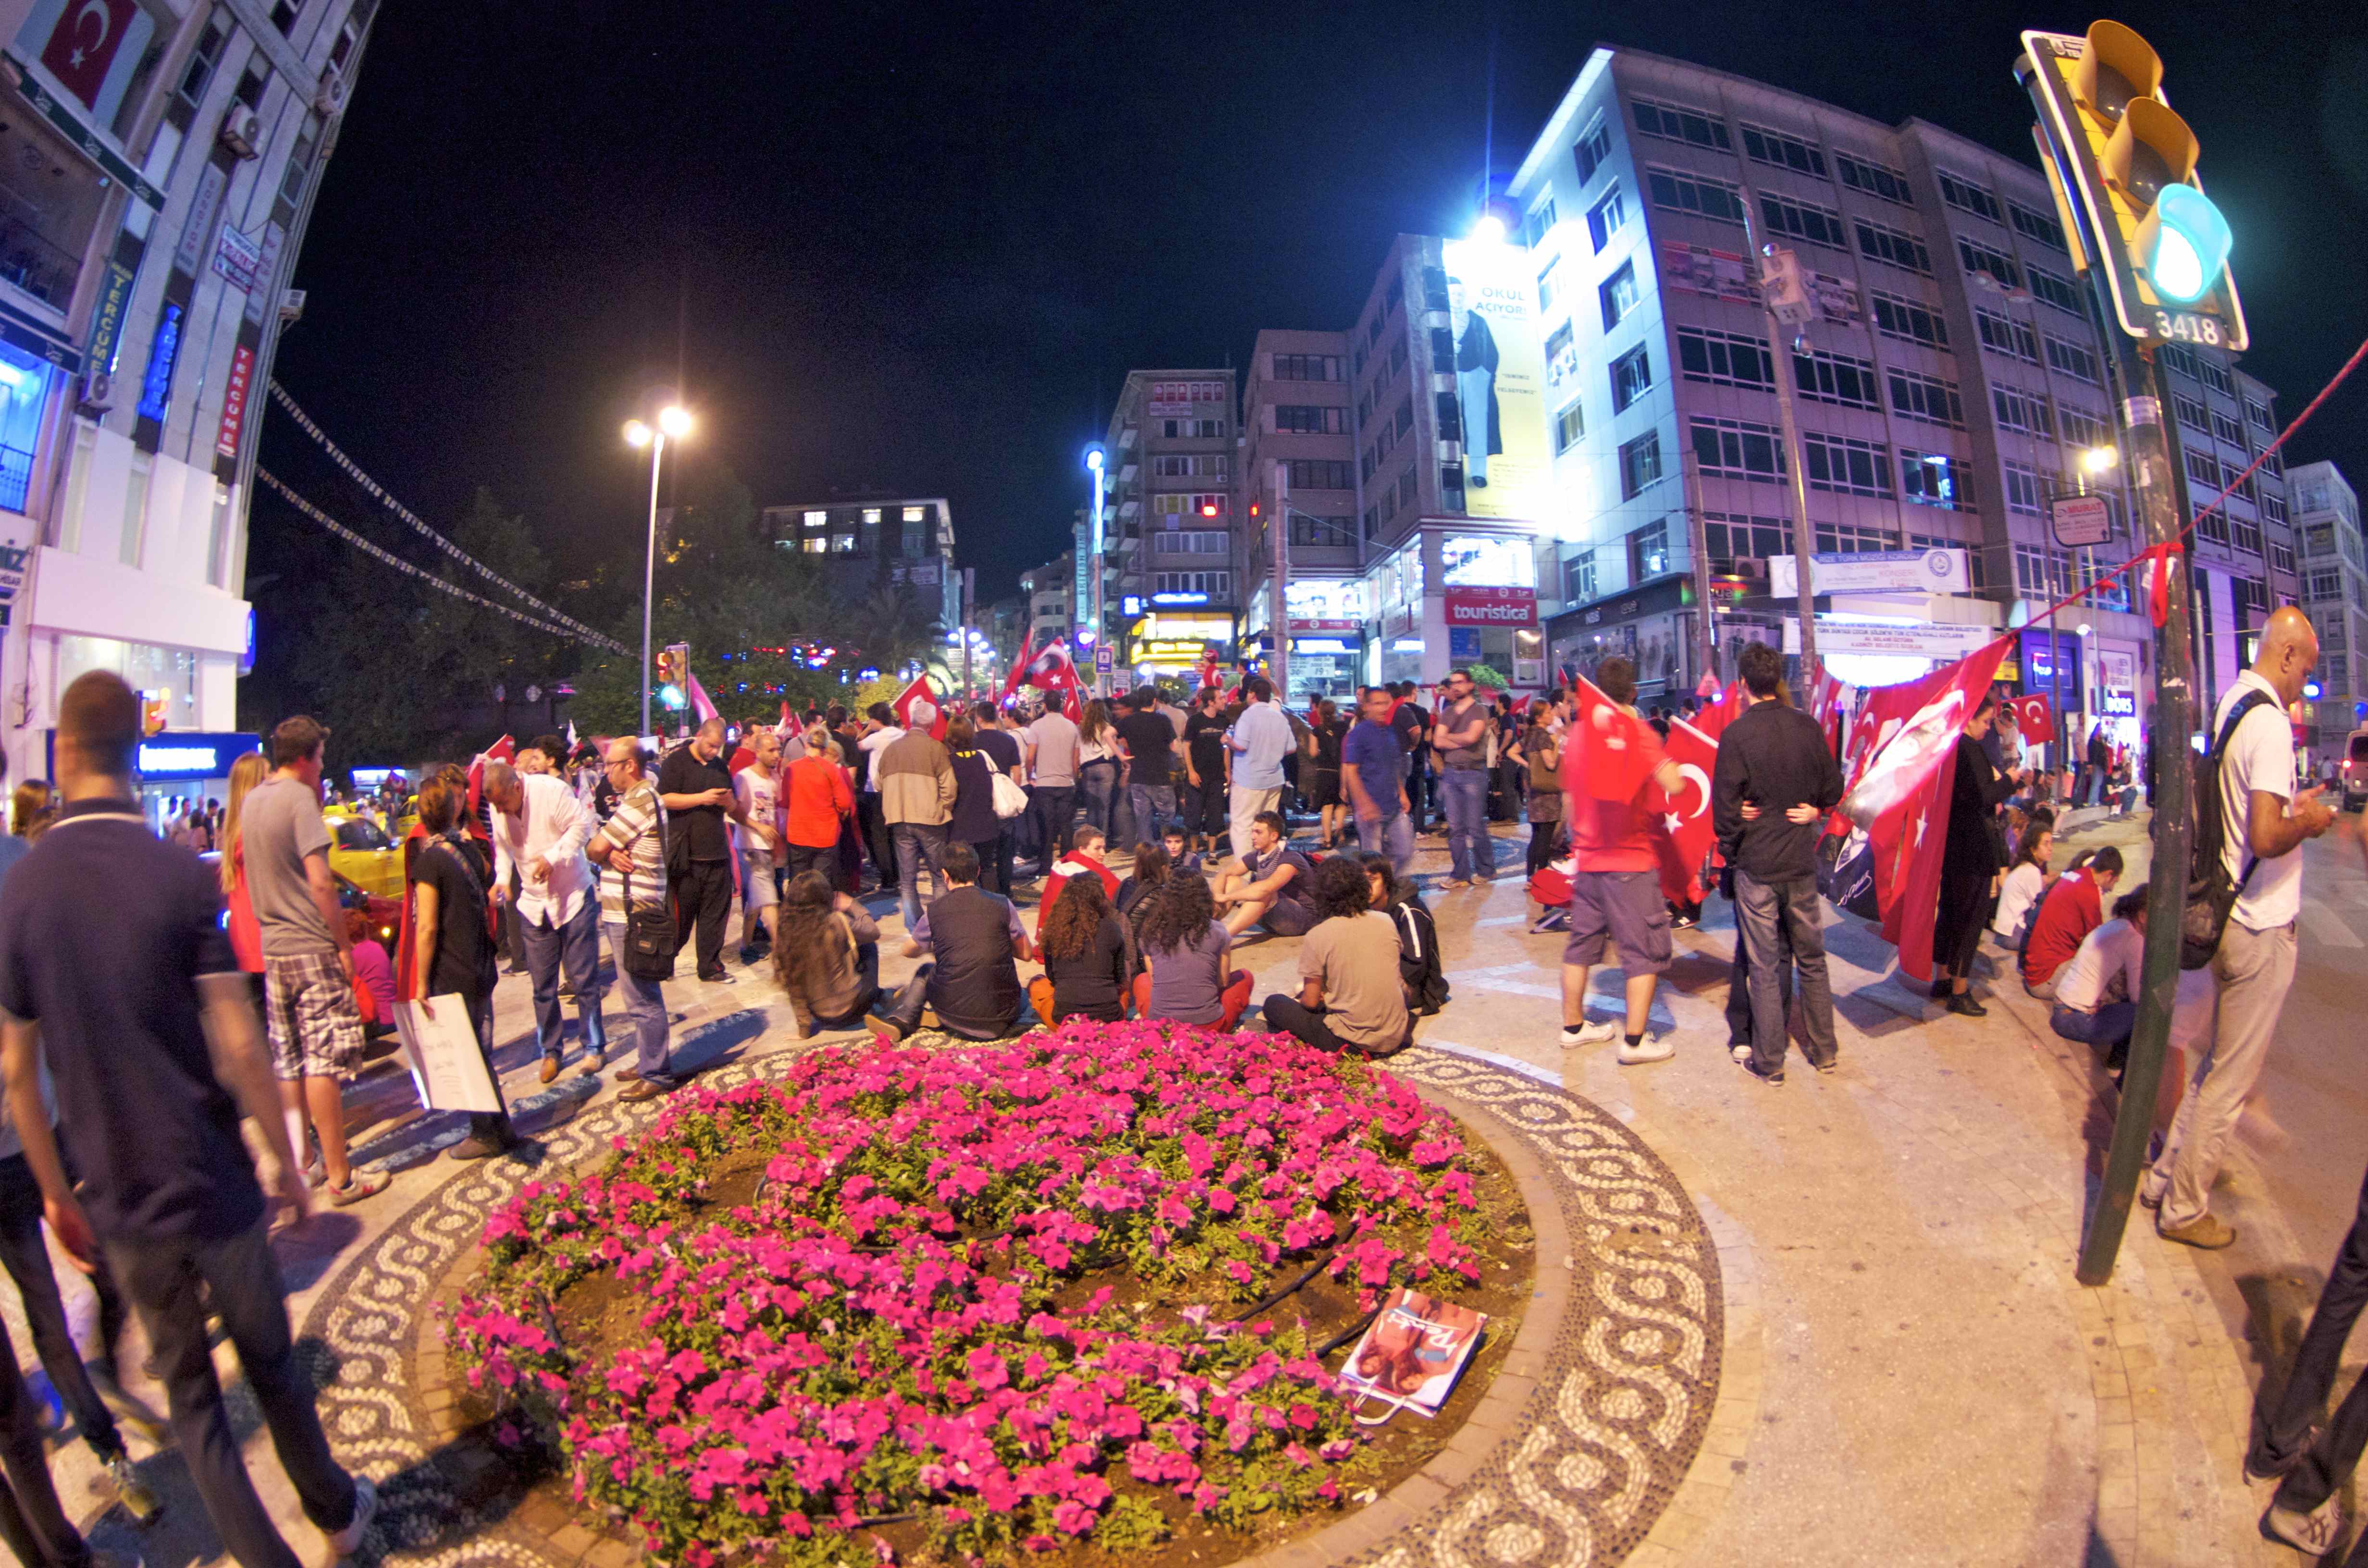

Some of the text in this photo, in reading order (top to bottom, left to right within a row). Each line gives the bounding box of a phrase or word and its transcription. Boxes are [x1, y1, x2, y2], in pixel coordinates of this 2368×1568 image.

[1482, 287, 1525, 301] OKUL
[2155, 311, 2219, 344] 3418
[2068, 502, 2103, 514] MURAT
[1454, 603, 1529, 620] touristica
[1387, 1313, 1458, 1357] Penti
